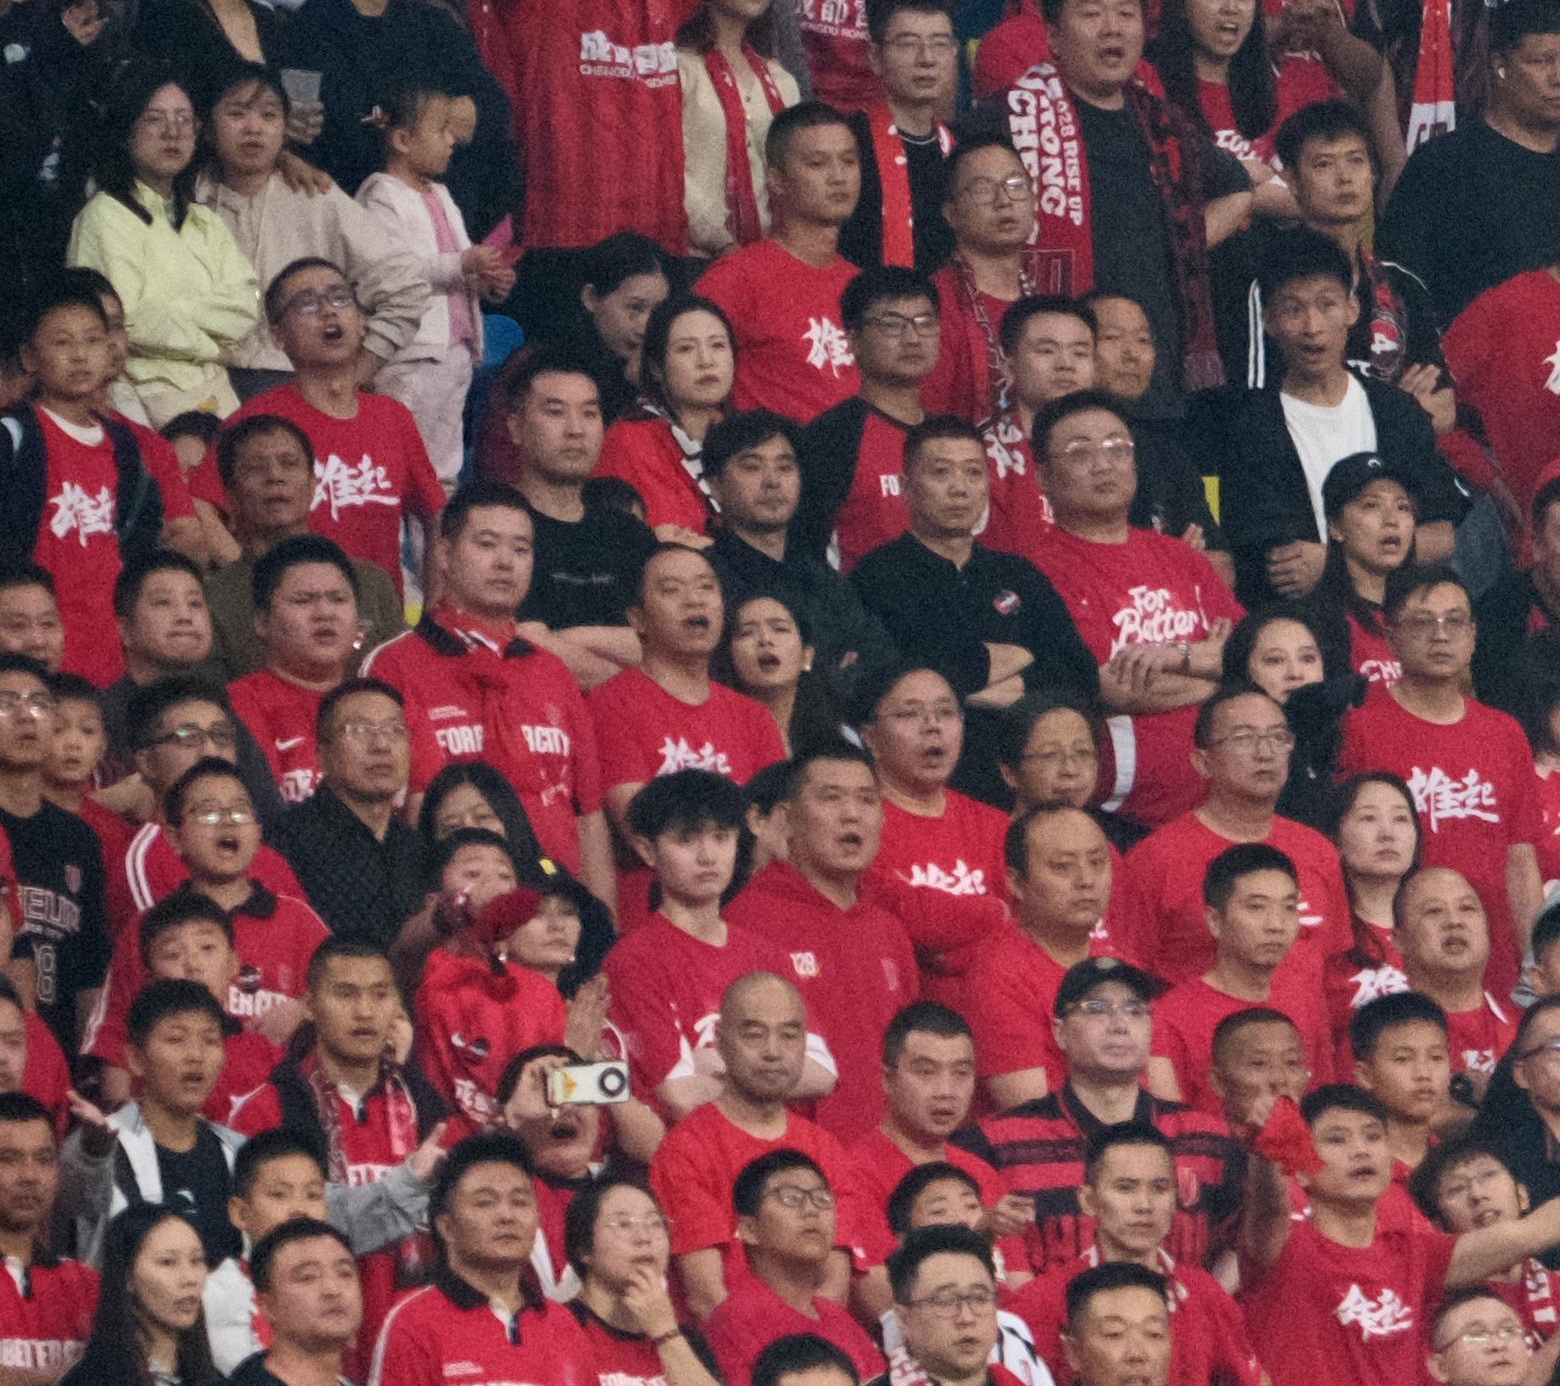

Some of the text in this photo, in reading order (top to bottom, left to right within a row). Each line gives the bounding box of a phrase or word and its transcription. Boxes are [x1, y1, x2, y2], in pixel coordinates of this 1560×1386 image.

[1129, 588, 1172, 612] For
[1113, 609, 1207, 645] Better
[1407, 766, 1499, 832] 雄起
